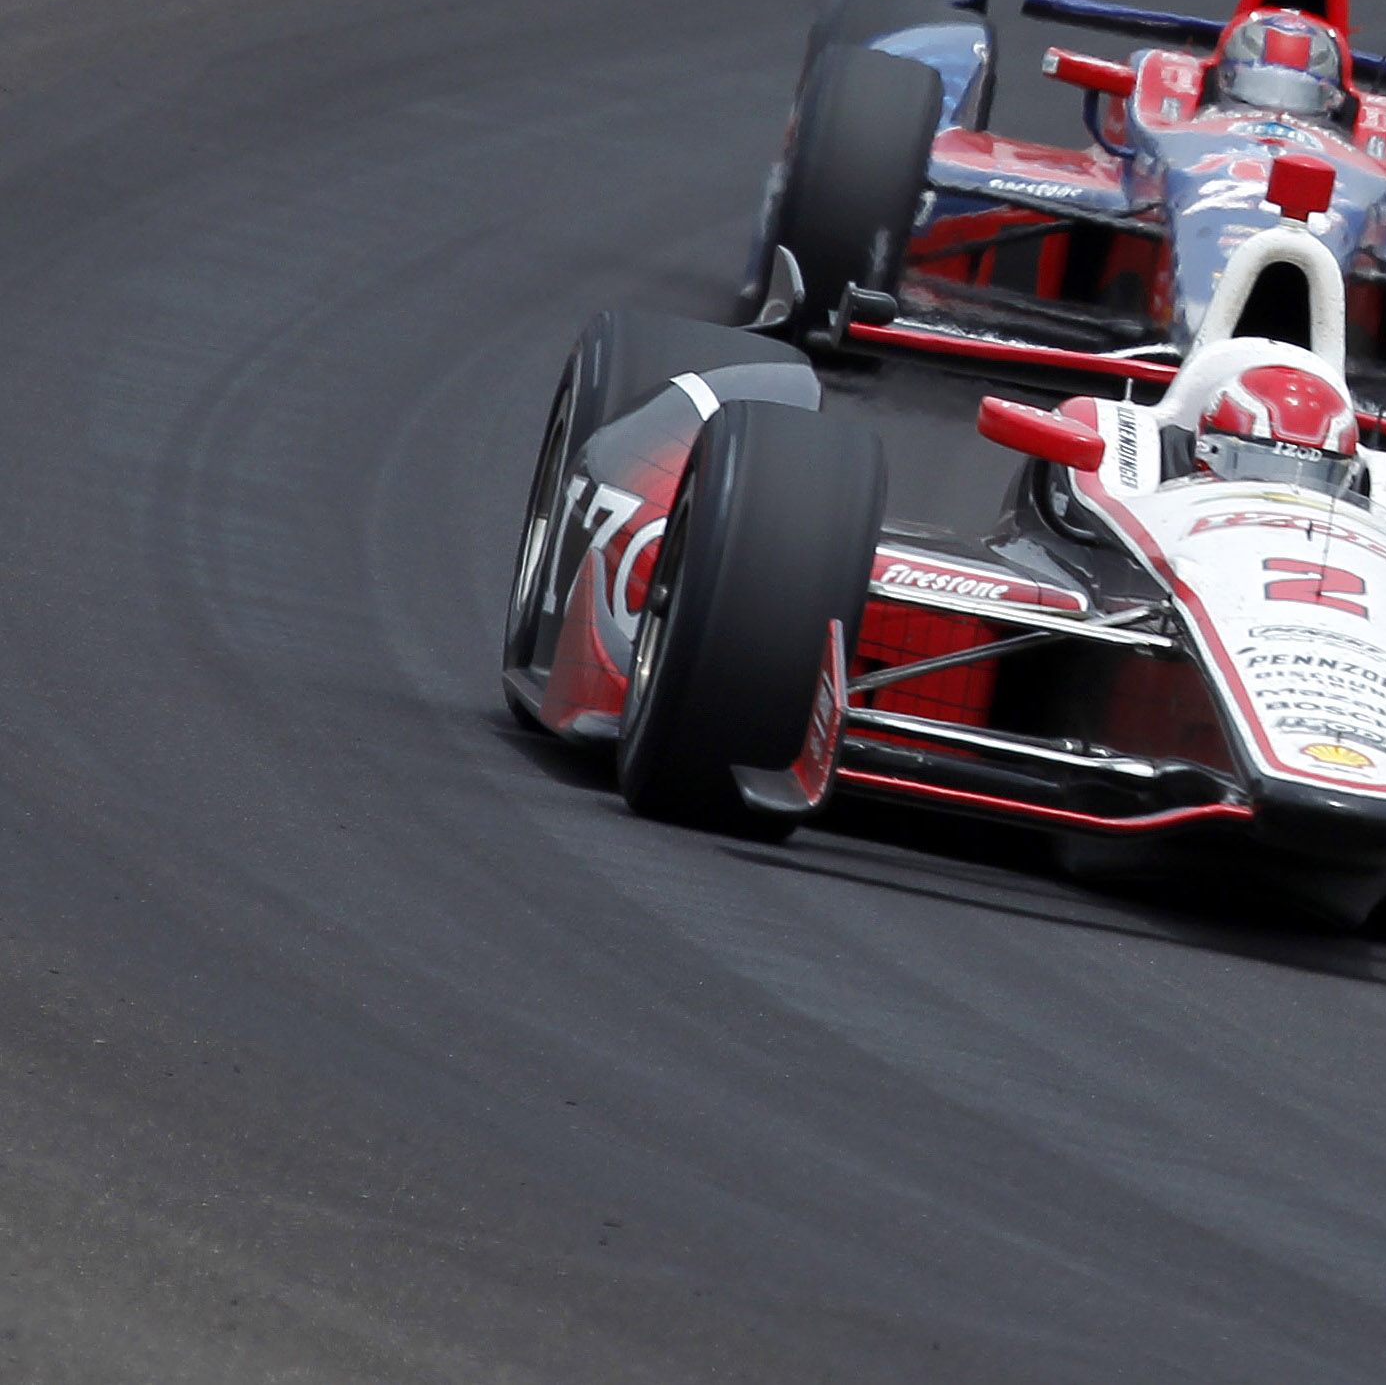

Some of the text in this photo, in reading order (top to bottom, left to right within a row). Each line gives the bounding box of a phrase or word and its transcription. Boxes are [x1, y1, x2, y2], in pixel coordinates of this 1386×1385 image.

[1272, 441, 1323, 462] IZOD
[881, 563, 1010, 600] Firestone
[1262, 557, 1369, 620] 2
